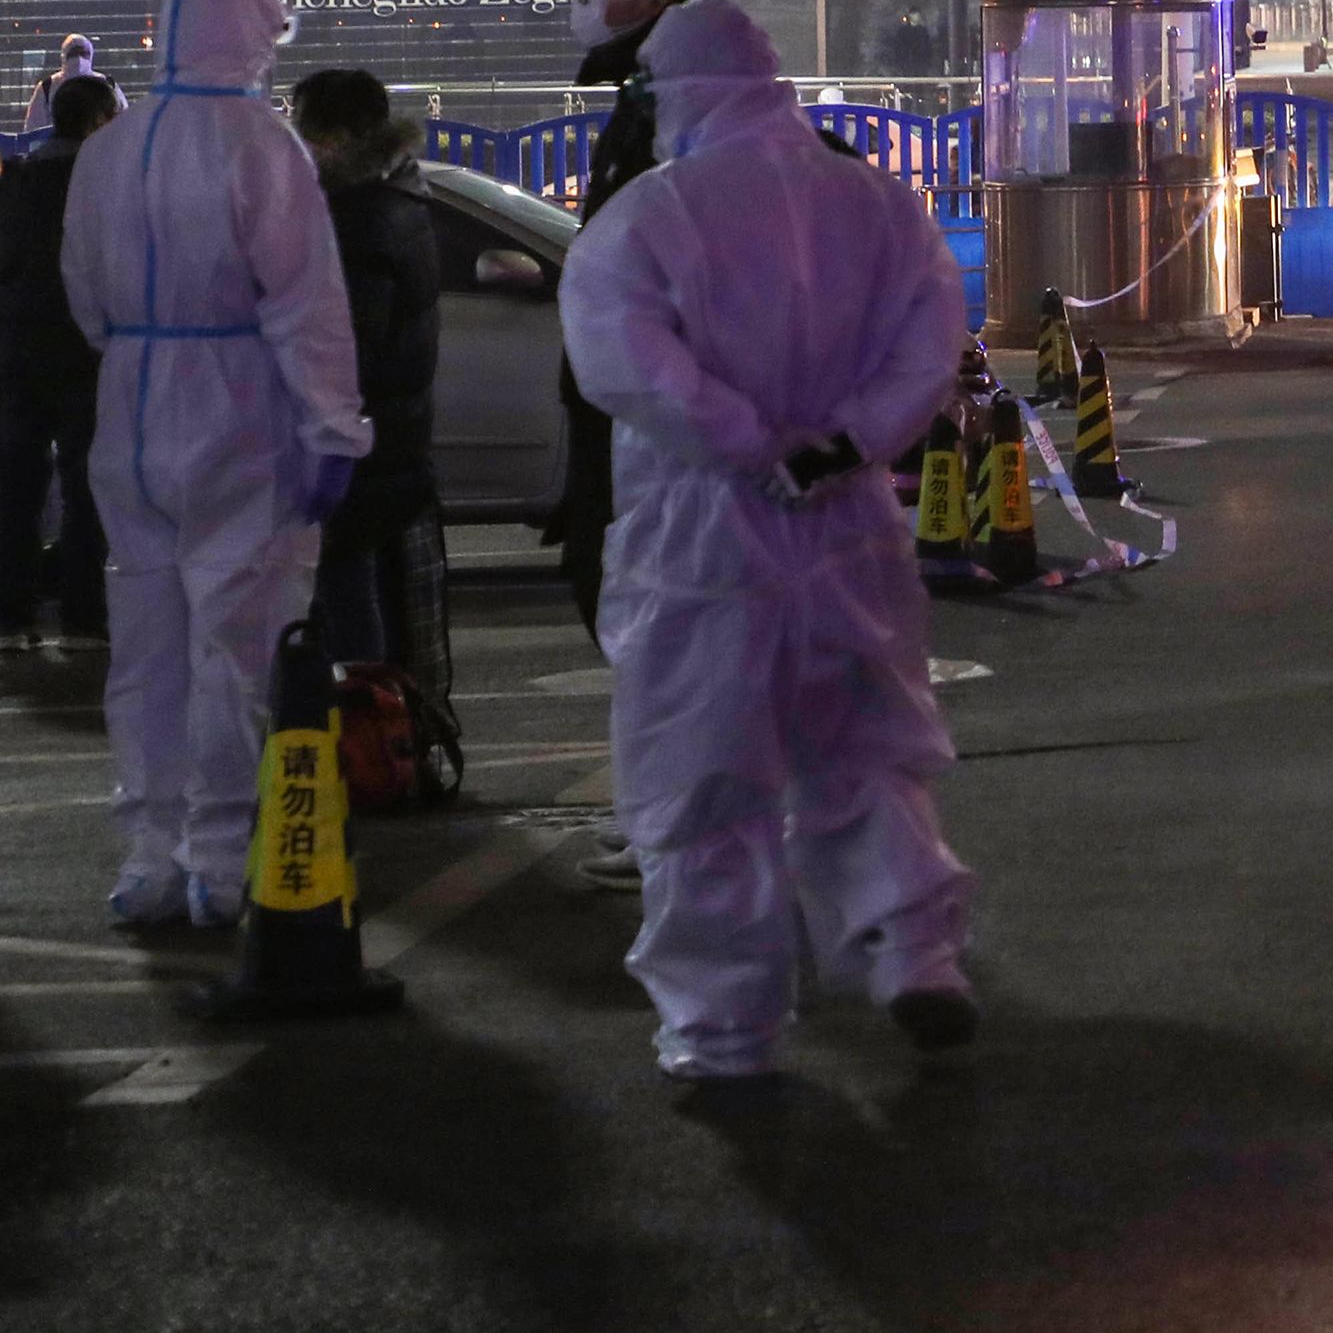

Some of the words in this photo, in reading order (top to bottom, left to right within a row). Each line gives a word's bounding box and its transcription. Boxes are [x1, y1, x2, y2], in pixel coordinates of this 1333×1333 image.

[930, 457, 949, 534] 请勿泊车
[278, 745, 318, 895] 请勿泊车
